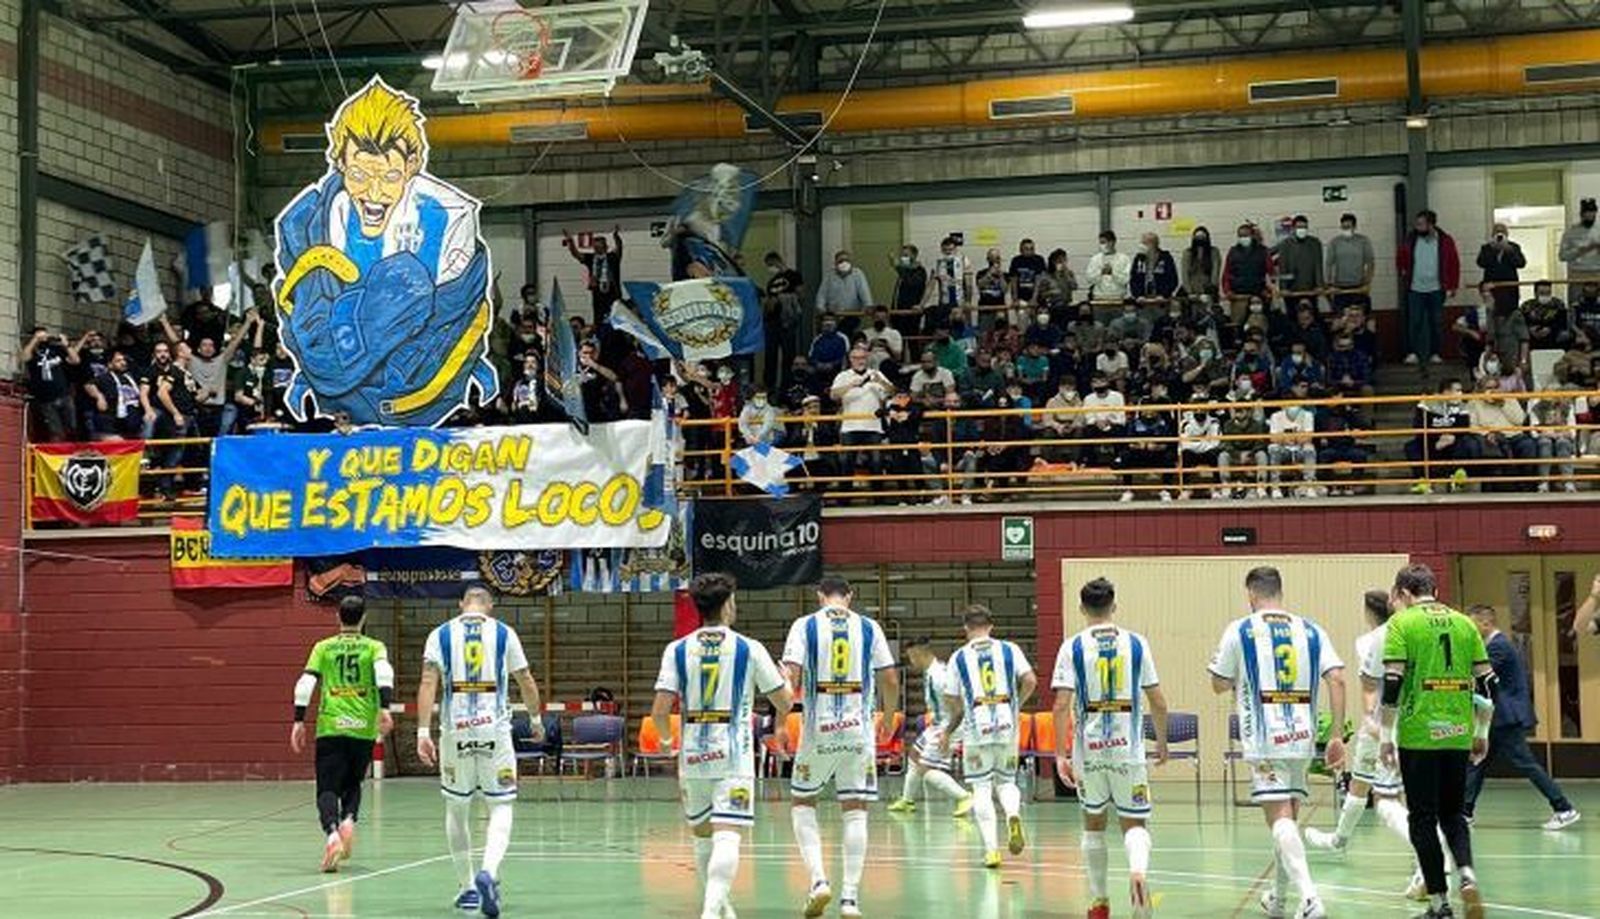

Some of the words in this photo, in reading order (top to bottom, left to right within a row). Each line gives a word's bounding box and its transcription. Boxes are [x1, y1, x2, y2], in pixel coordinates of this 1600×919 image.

[308, 448, 332, 476] Y
[339, 446, 401, 480] QUE
[411, 434, 532, 474] DIGAN
[220, 482, 293, 537] QUE
[301, 474, 494, 533] ESTAMOS
[335, 654, 360, 683] 15
[464, 641, 485, 677] 9
[831, 637, 850, 679] 8
[1274, 644, 1298, 684] 3
[1439, 633, 1453, 671] 1
[701, 663, 720, 706] 7
[979, 661, 996, 694] 6
[1095, 655, 1124, 695] 11
